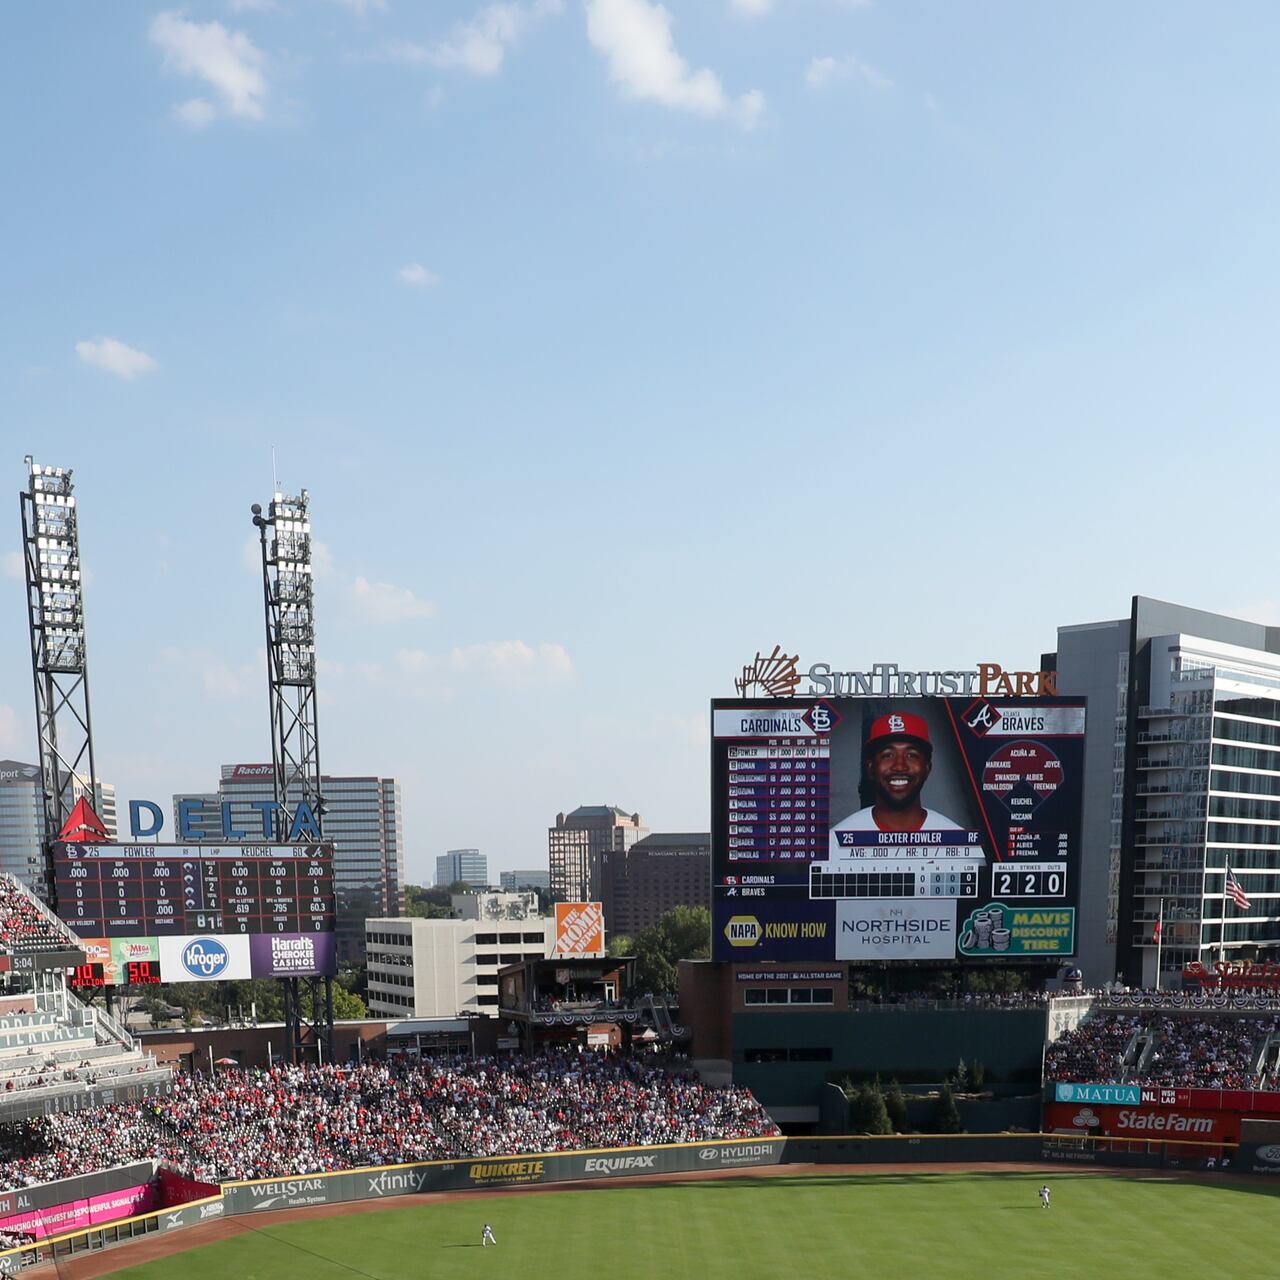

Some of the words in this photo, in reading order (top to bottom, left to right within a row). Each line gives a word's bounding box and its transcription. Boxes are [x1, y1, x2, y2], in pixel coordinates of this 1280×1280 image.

[740, 718, 801, 733] CARDINALS
[1002, 717, 1044, 731] BRAVES
[237, 766, 274, 775] RaceTra
[129, 800, 320, 838] DELTA
[843, 833, 854, 844] 25
[878, 833, 908, 843] DEXTER
[910, 832, 942, 843] FOWLER
[968, 832, 979, 842] RF
[88, 847, 99, 857] 25
[123, 847, 155, 857] FOWLER
[241, 848, 273, 857] KEUCHEL
[293, 848, 303, 857] 60
[850, 849, 867, 857] AVG:
[741, 876, 775, 884] CARDINALS
[1000, 874, 1011, 893] 2
[1024, 874, 1035, 893] 2
[1048, 874, 1060, 893] 0
[742, 888, 765, 896] BRAVES
[560, 908, 580, 929] THE
[1013, 913, 1070, 925] MAVIS
[558, 904, 600, 953] HOME
[730, 924, 756, 938] NAPA
[765, 923, 798, 938] KNOW
[801, 922, 827, 937] HOW
[842, 920, 951, 932] NORTHSIDE
[575, 920, 602, 953] DEPOT
[1012, 928, 1070, 938] DISCOUNT
[861, 935, 930, 944] HOSPITAL
[1021, 940, 1059, 950] TIRE
[187, 944, 225, 974] Kroger
[273, 950, 314, 959] CHEROKEE
[14, 956, 33, 968] 5:04
[273, 959, 315, 967] CASINOS
[129, 962, 149, 978] 50
[1077, 1087, 1136, 1101] MATUA
[1142, 1091, 1157, 1101] NL
[721, 1145, 773, 1156] HYUNDAI
[470, 1161, 544, 1179] QUIKRETE
[584, 1156, 655, 1174] EQUIFAX
[251, 1179, 323, 1196] WELLSTAR
[369, 1169, 427, 1195] xfinity
[17, 1195, 31, 1209] AL
[288, 1197, 305, 1205] Health
[307, 1195, 326, 1203] System
